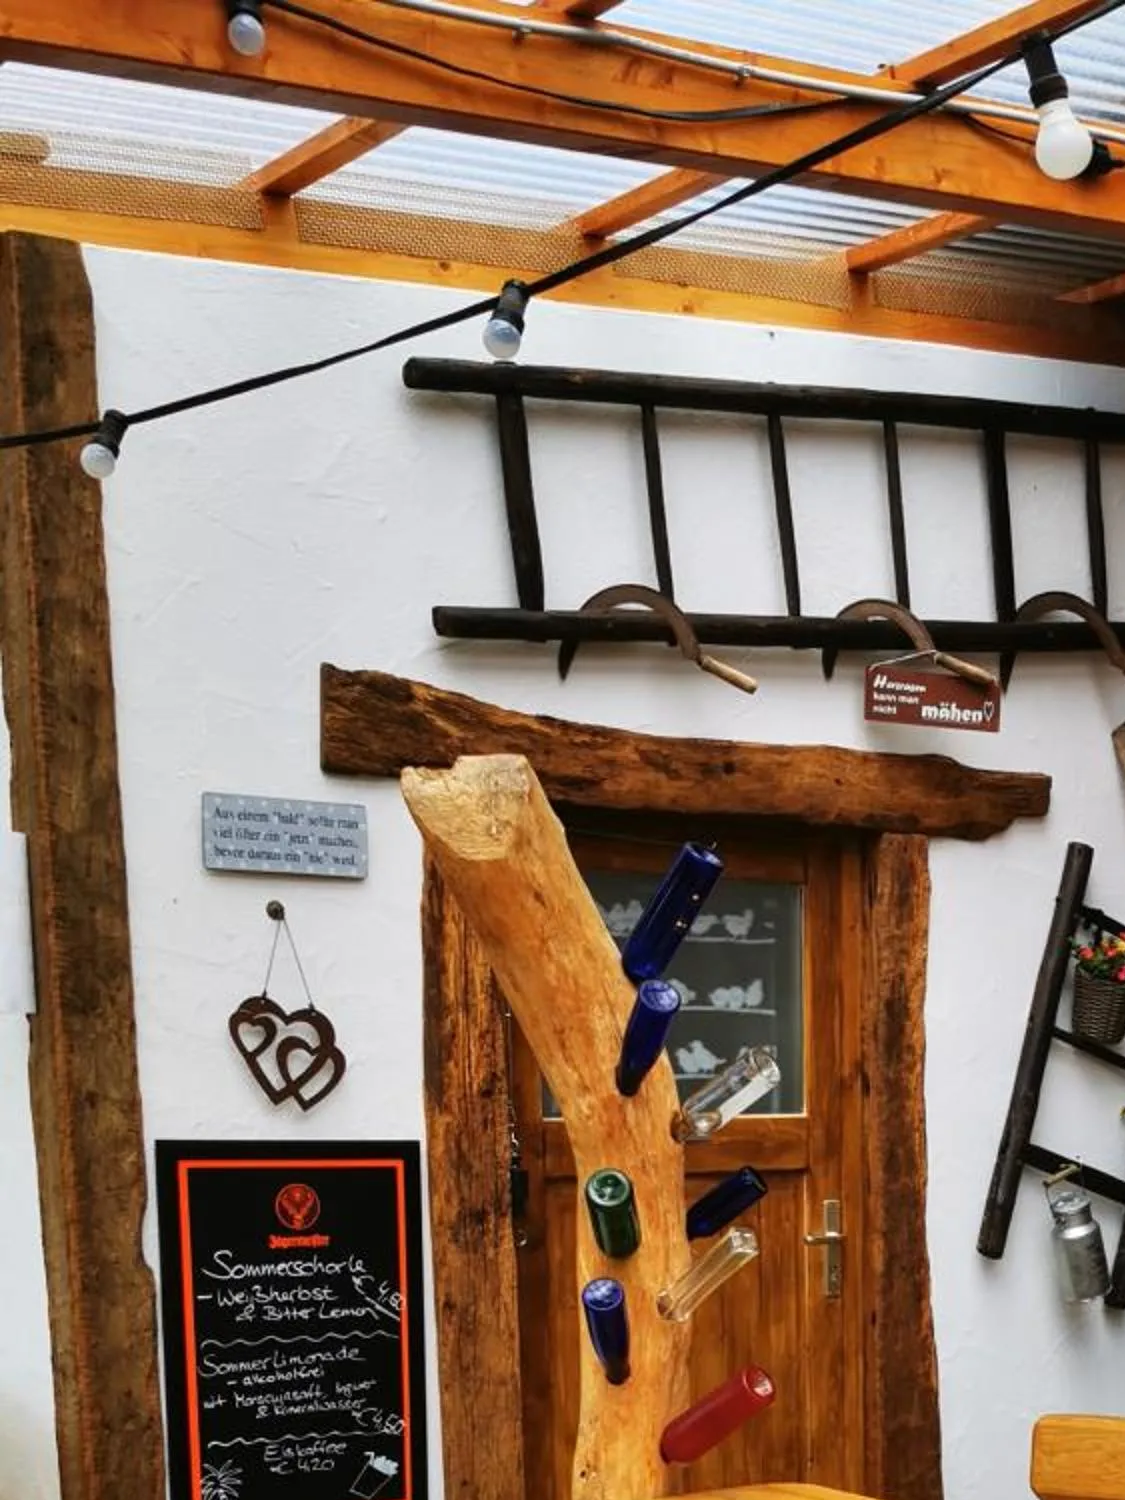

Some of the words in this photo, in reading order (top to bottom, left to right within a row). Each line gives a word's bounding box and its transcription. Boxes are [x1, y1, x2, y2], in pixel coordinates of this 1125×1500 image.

[873, 692, 896, 702] kann
[898, 695, 919, 705] man
[872, 705, 897, 715] nicht
[921, 700, 984, 722] mähen
[201, 1250, 368, 1279] Sommerschorle
[217, 1285, 339, 1306] Weißherbst
[263, 1305, 315, 1320] Bitter
[319, 1303, 379, 1320] Lemon
